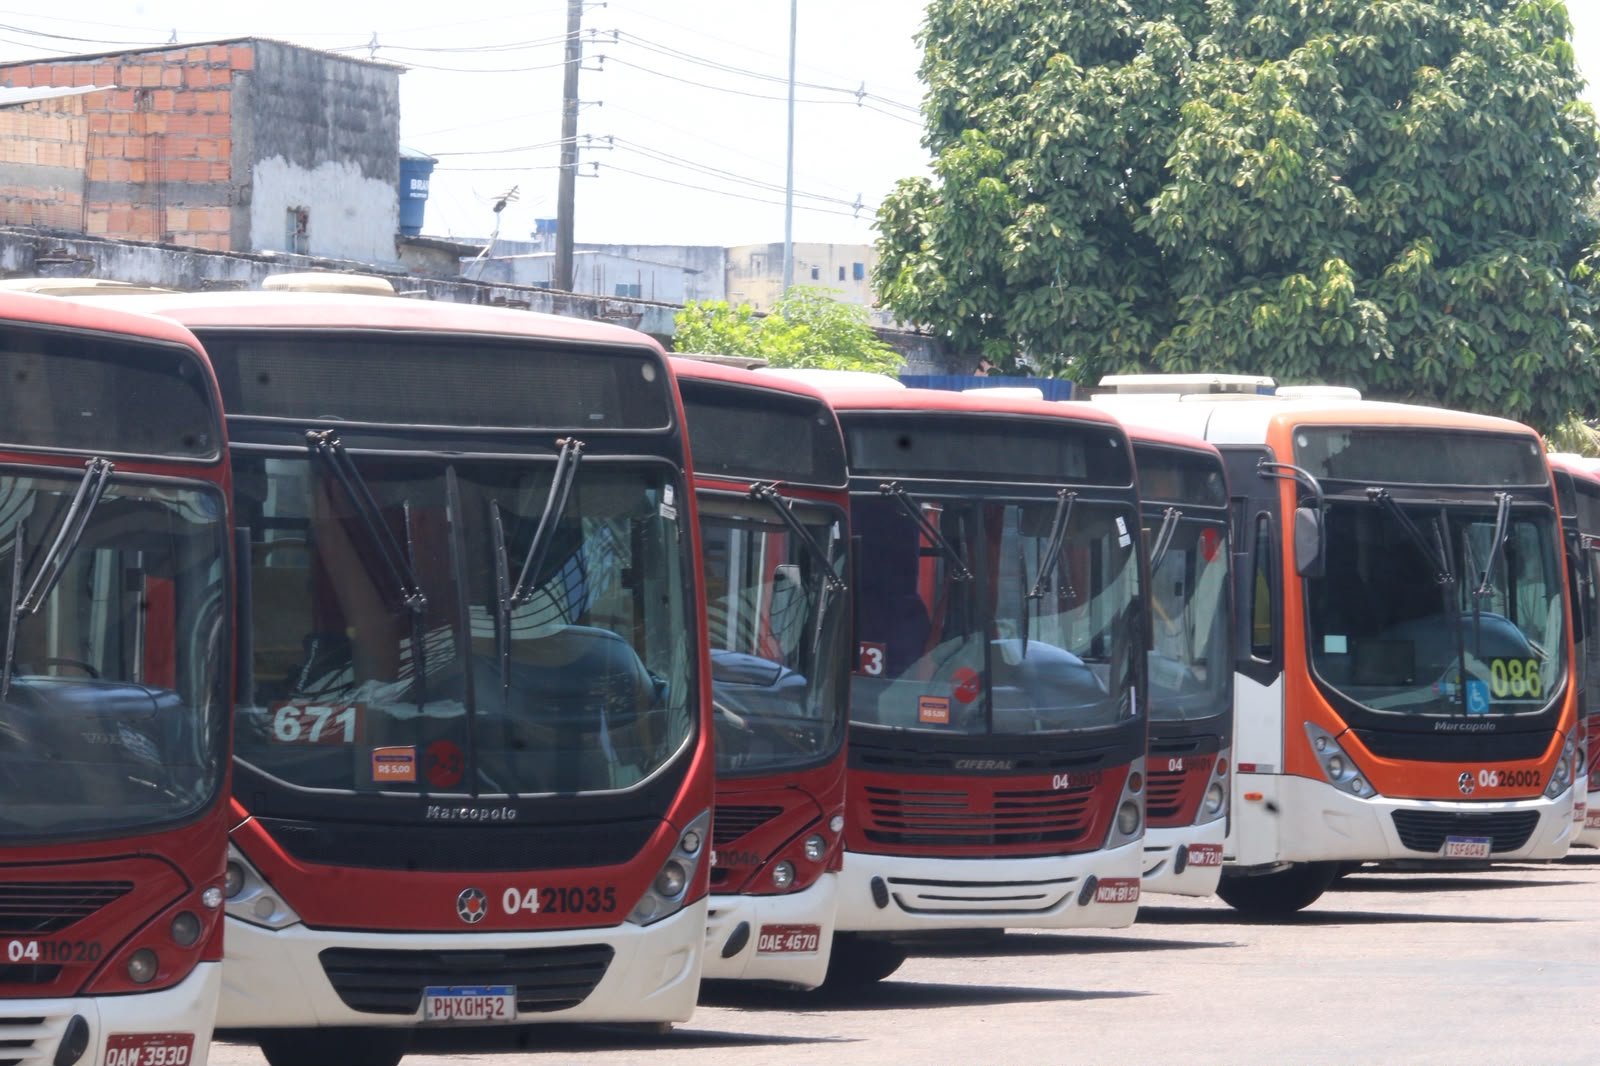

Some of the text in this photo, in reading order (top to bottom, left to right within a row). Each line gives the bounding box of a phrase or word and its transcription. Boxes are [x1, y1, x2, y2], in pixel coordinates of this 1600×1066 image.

[1491, 658, 1541, 698] 086
[273, 706, 356, 743] 671
[377, 763, 390, 774] R$
[955, 760, 1013, 770] CIFERAL
[426, 805, 517, 821] Marcopolo
